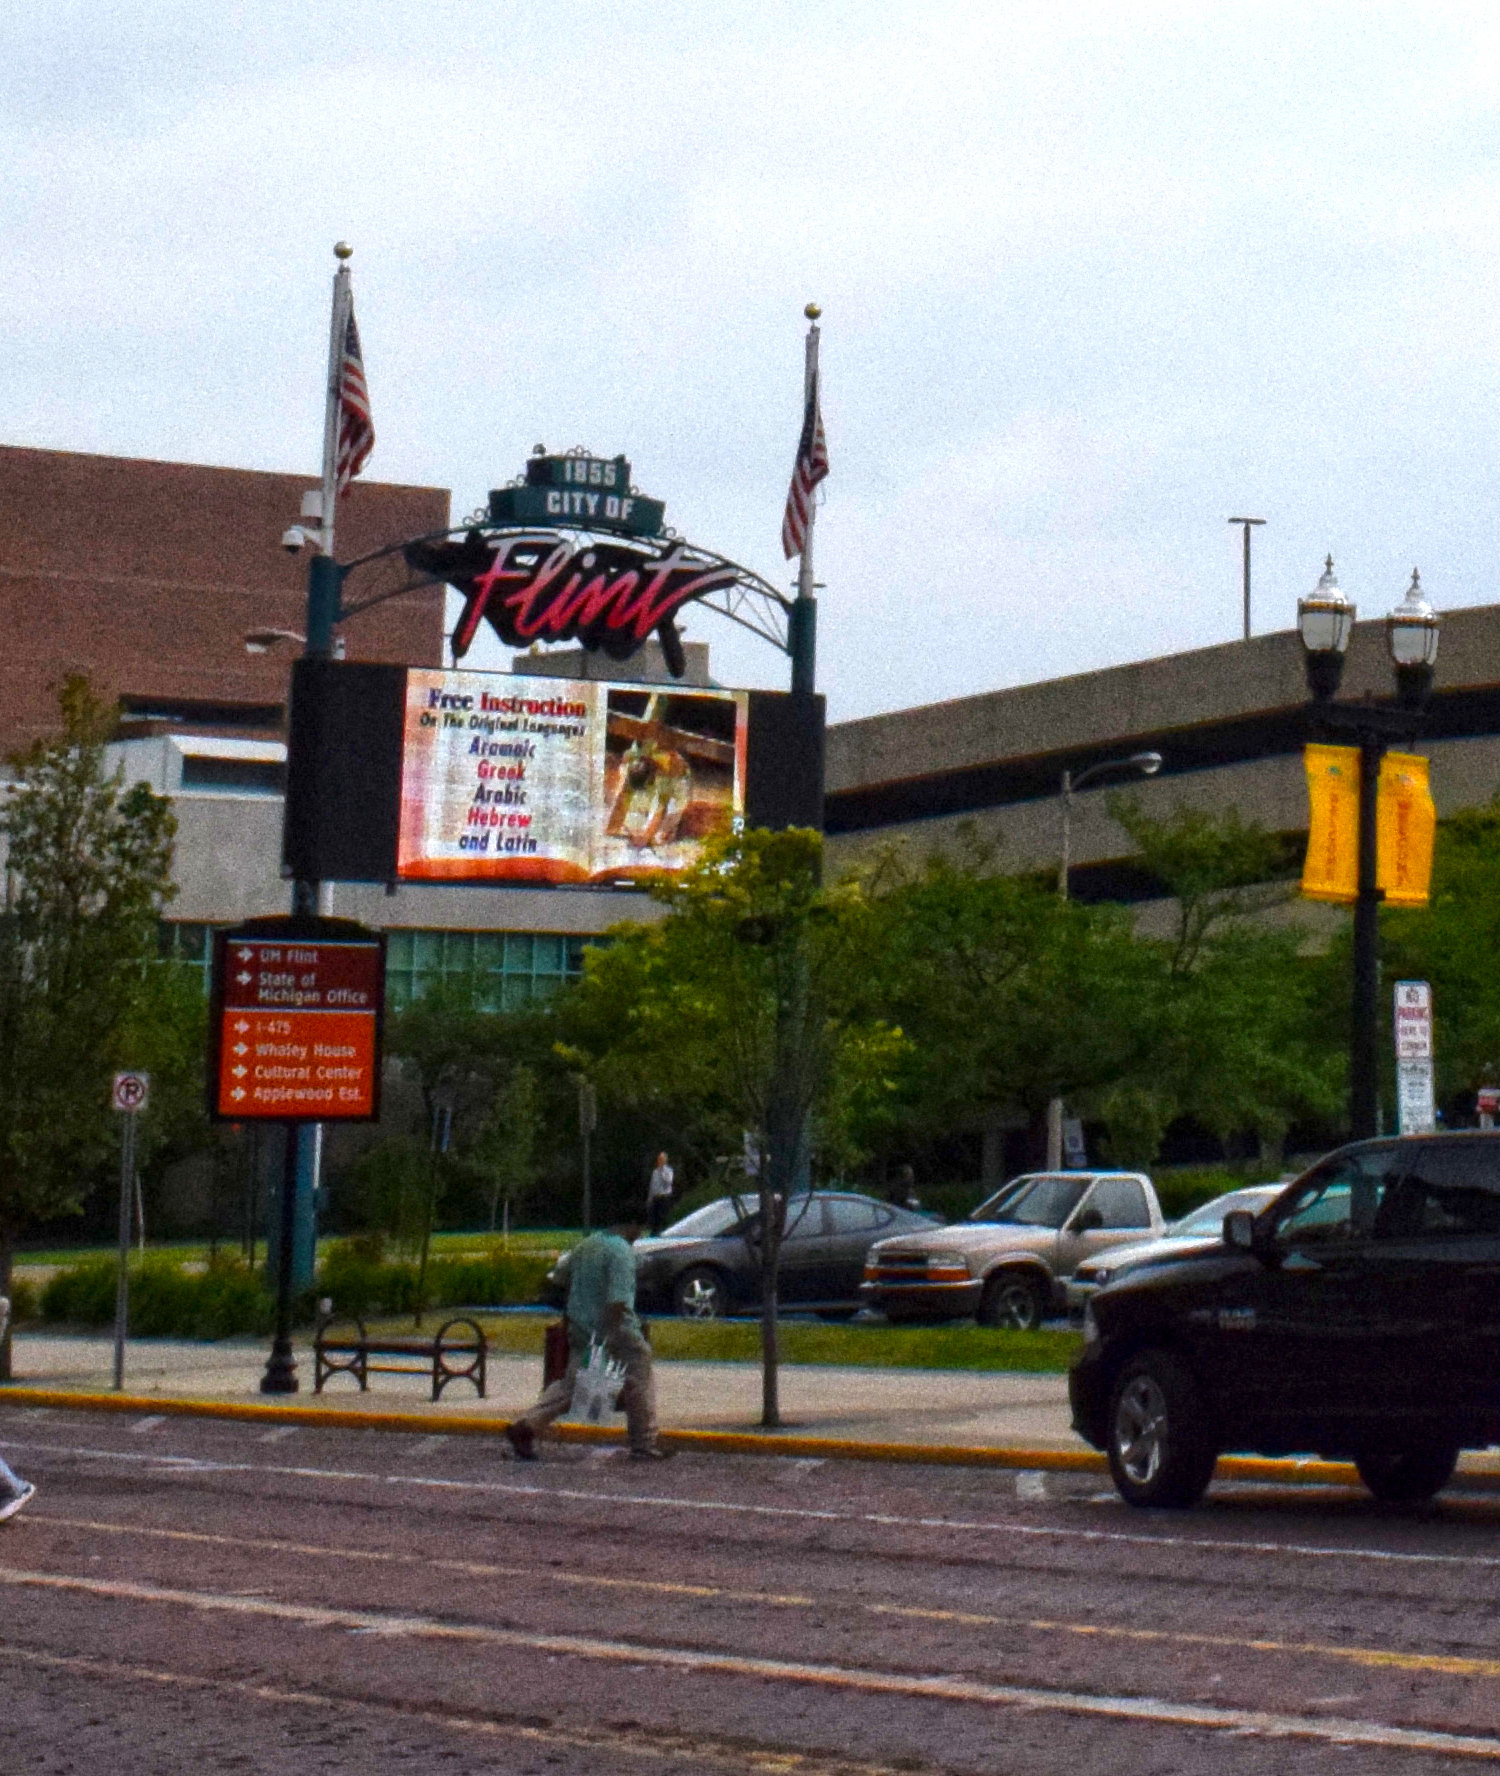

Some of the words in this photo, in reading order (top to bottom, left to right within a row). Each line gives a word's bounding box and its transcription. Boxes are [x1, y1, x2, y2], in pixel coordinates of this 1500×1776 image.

[564, 460, 616, 486] 1855
[547, 491, 599, 517] CITY
[605, 495, 635, 520] OF
[460, 534, 739, 647] Flint
[428, 688, 473, 710] Free
[480, 692, 586, 717] Instruction
[420, 711, 436, 727] On
[443, 713, 464, 728] The
[469, 714, 519, 735] Original
[523, 718, 586, 739] Languages
[469, 735, 536, 758] Aramaic
[477, 759, 526, 781] Greek
[473, 782, 527, 804] Arabic
[467, 806, 532, 827] Hebrew
[459, 829, 489, 851] and
[496, 831, 537, 853] Latin
[260, 949, 281, 962] UM
[287, 949, 318, 963] Flint
[259, 972, 295, 986] State
[301, 973, 316, 986] of
[258, 988, 321, 1005] Michigan
[327, 989, 368, 1004] Office
[255, 1043, 308, 1060] Whaley
[314, 1044, 357, 1058] House
[255, 1065, 310, 1079] Cultural
[316, 1065, 363, 1079] Center
[254, 1086, 333, 1103] Applewood
